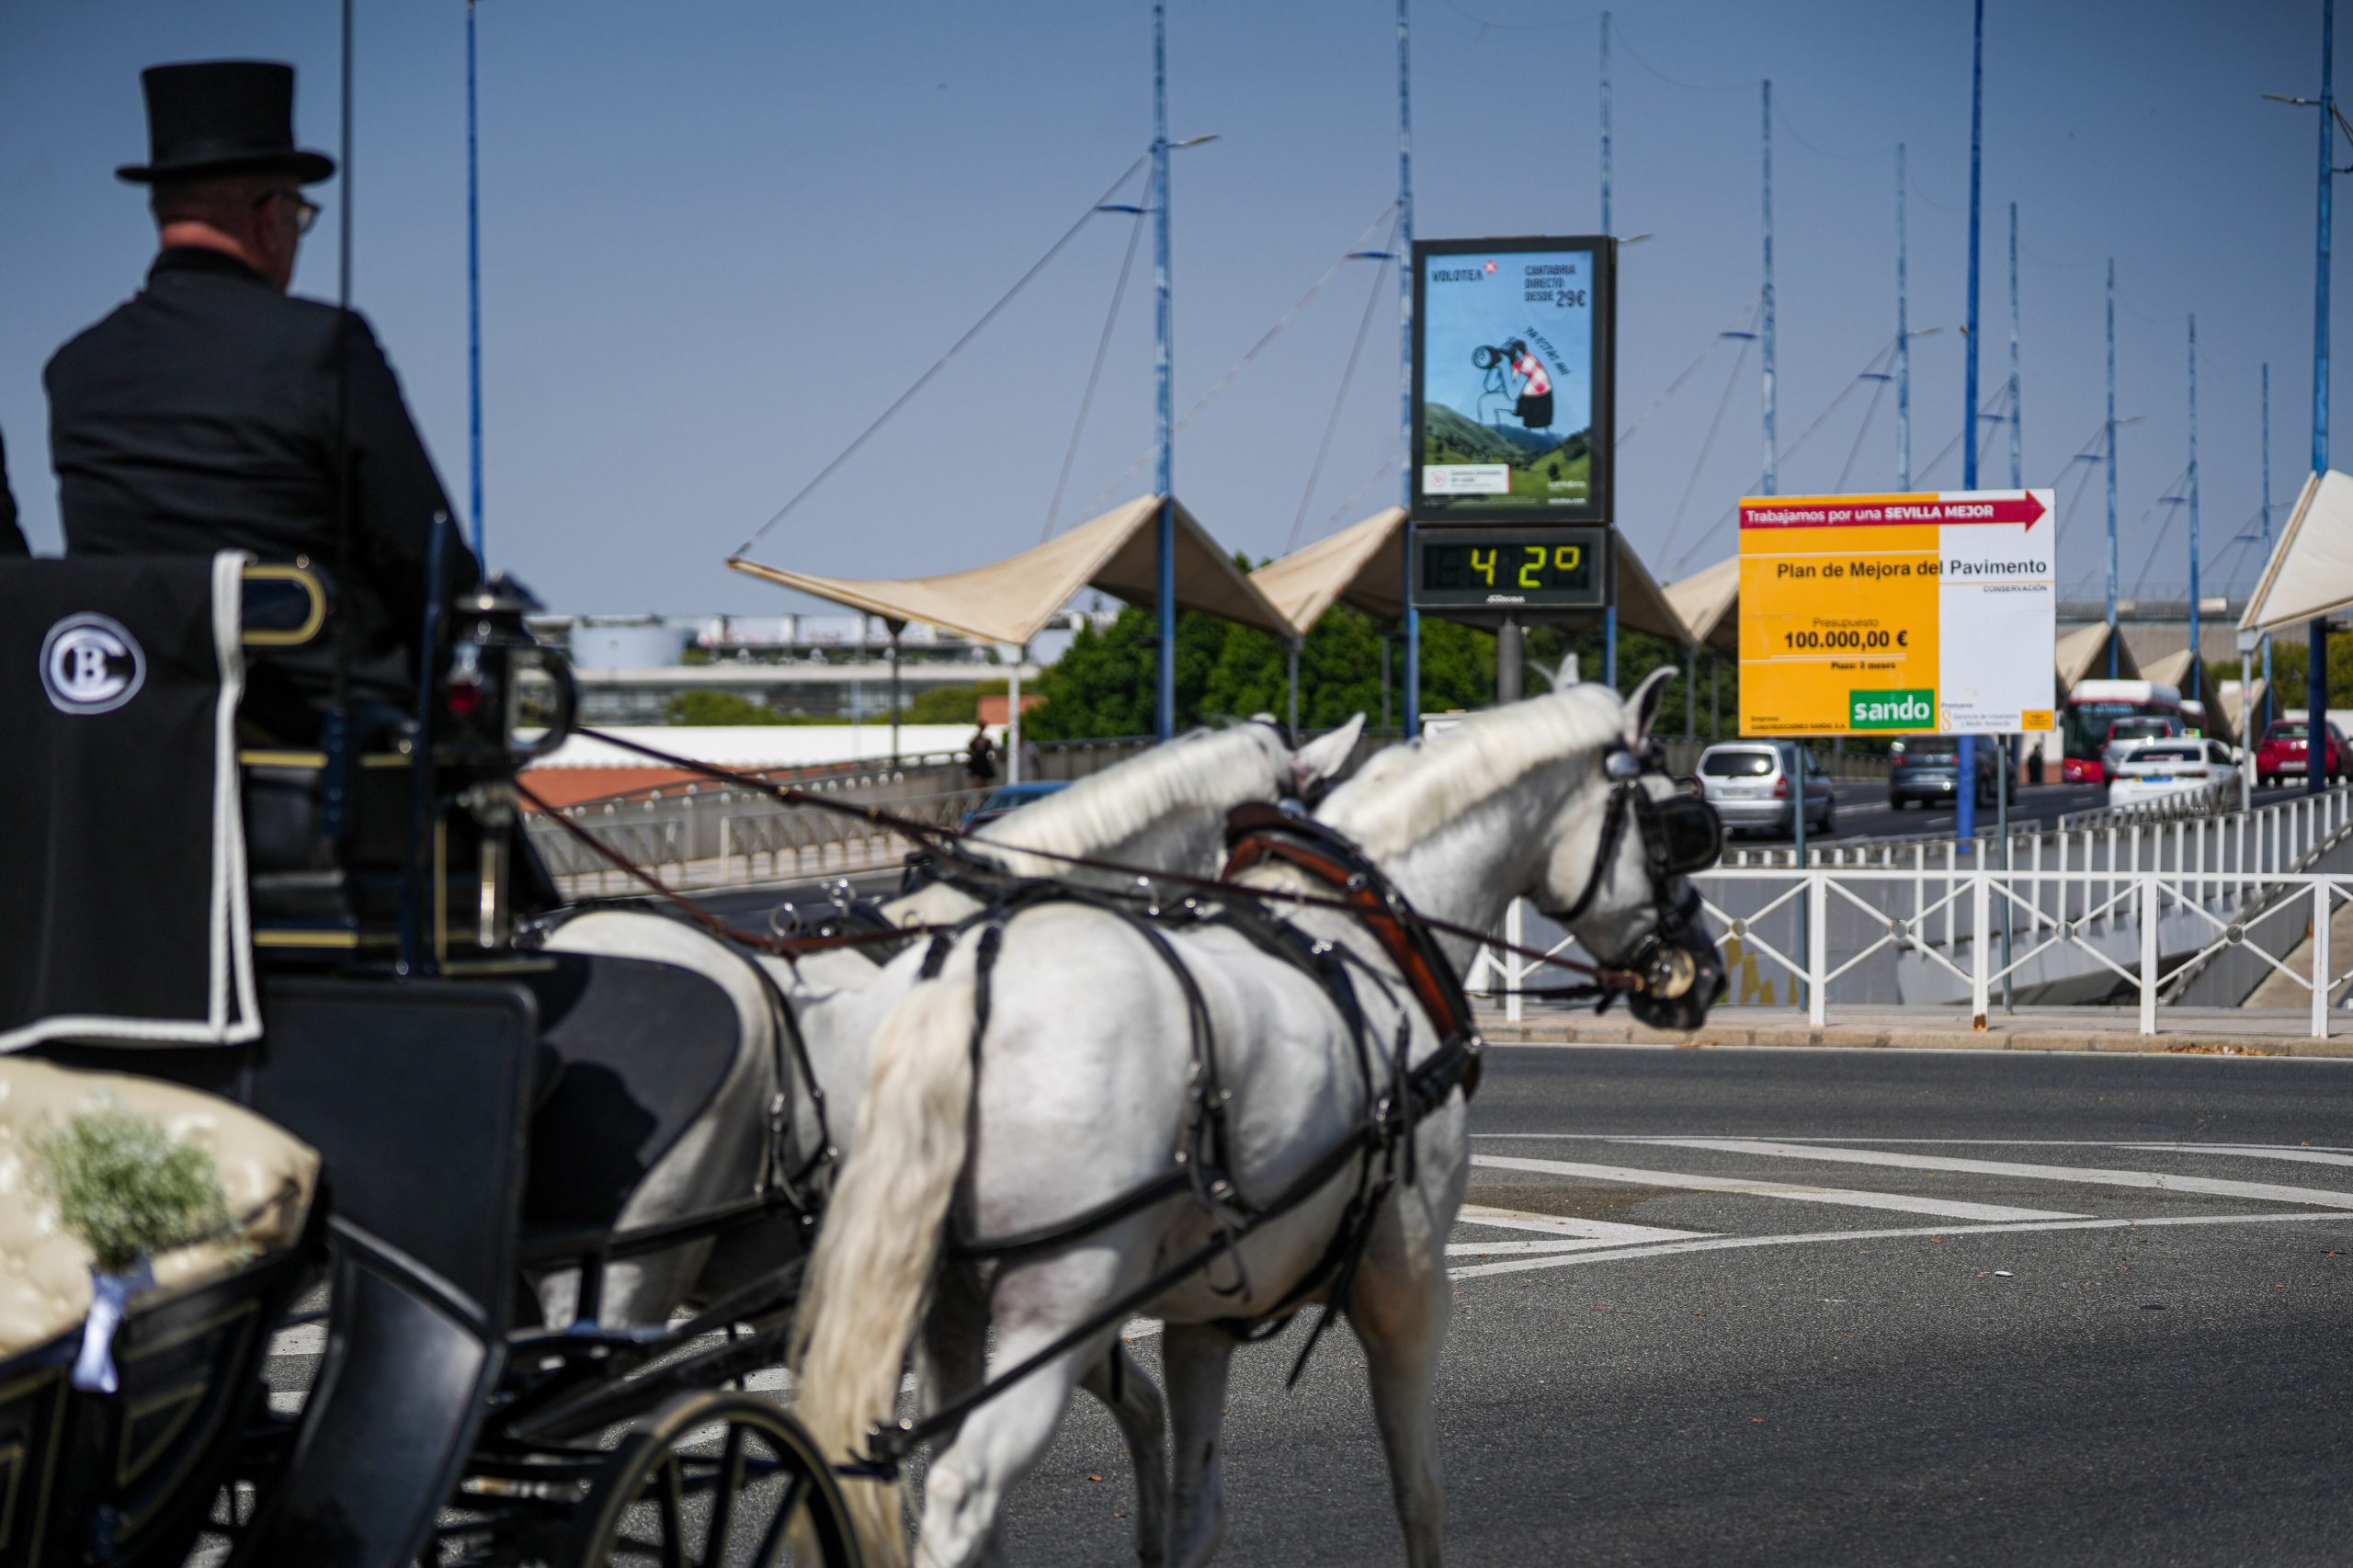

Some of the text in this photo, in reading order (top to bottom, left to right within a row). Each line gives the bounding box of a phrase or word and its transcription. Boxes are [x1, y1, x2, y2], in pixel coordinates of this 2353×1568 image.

[1431, 268, 1483, 282] VOLOTEA
[1524, 265, 1576, 276] CANTABRIA
[1524, 278, 1564, 289] DIRECTO
[1524, 290, 1587, 308] DESDE 29€
[1745, 505, 1995, 525] Trabajamos por una SEVILLA MEJOR
[1778, 558, 2047, 581] Plan de Mejora del Pavimento
[1983, 583, 2048, 595] CONSERVACIÓN
[1812, 617, 1880, 630] Presupuesto
[1784, 630, 1909, 651] 100.000,00 €
[1868, 662, 1896, 670] meses
[1854, 695, 1931, 722] sando
